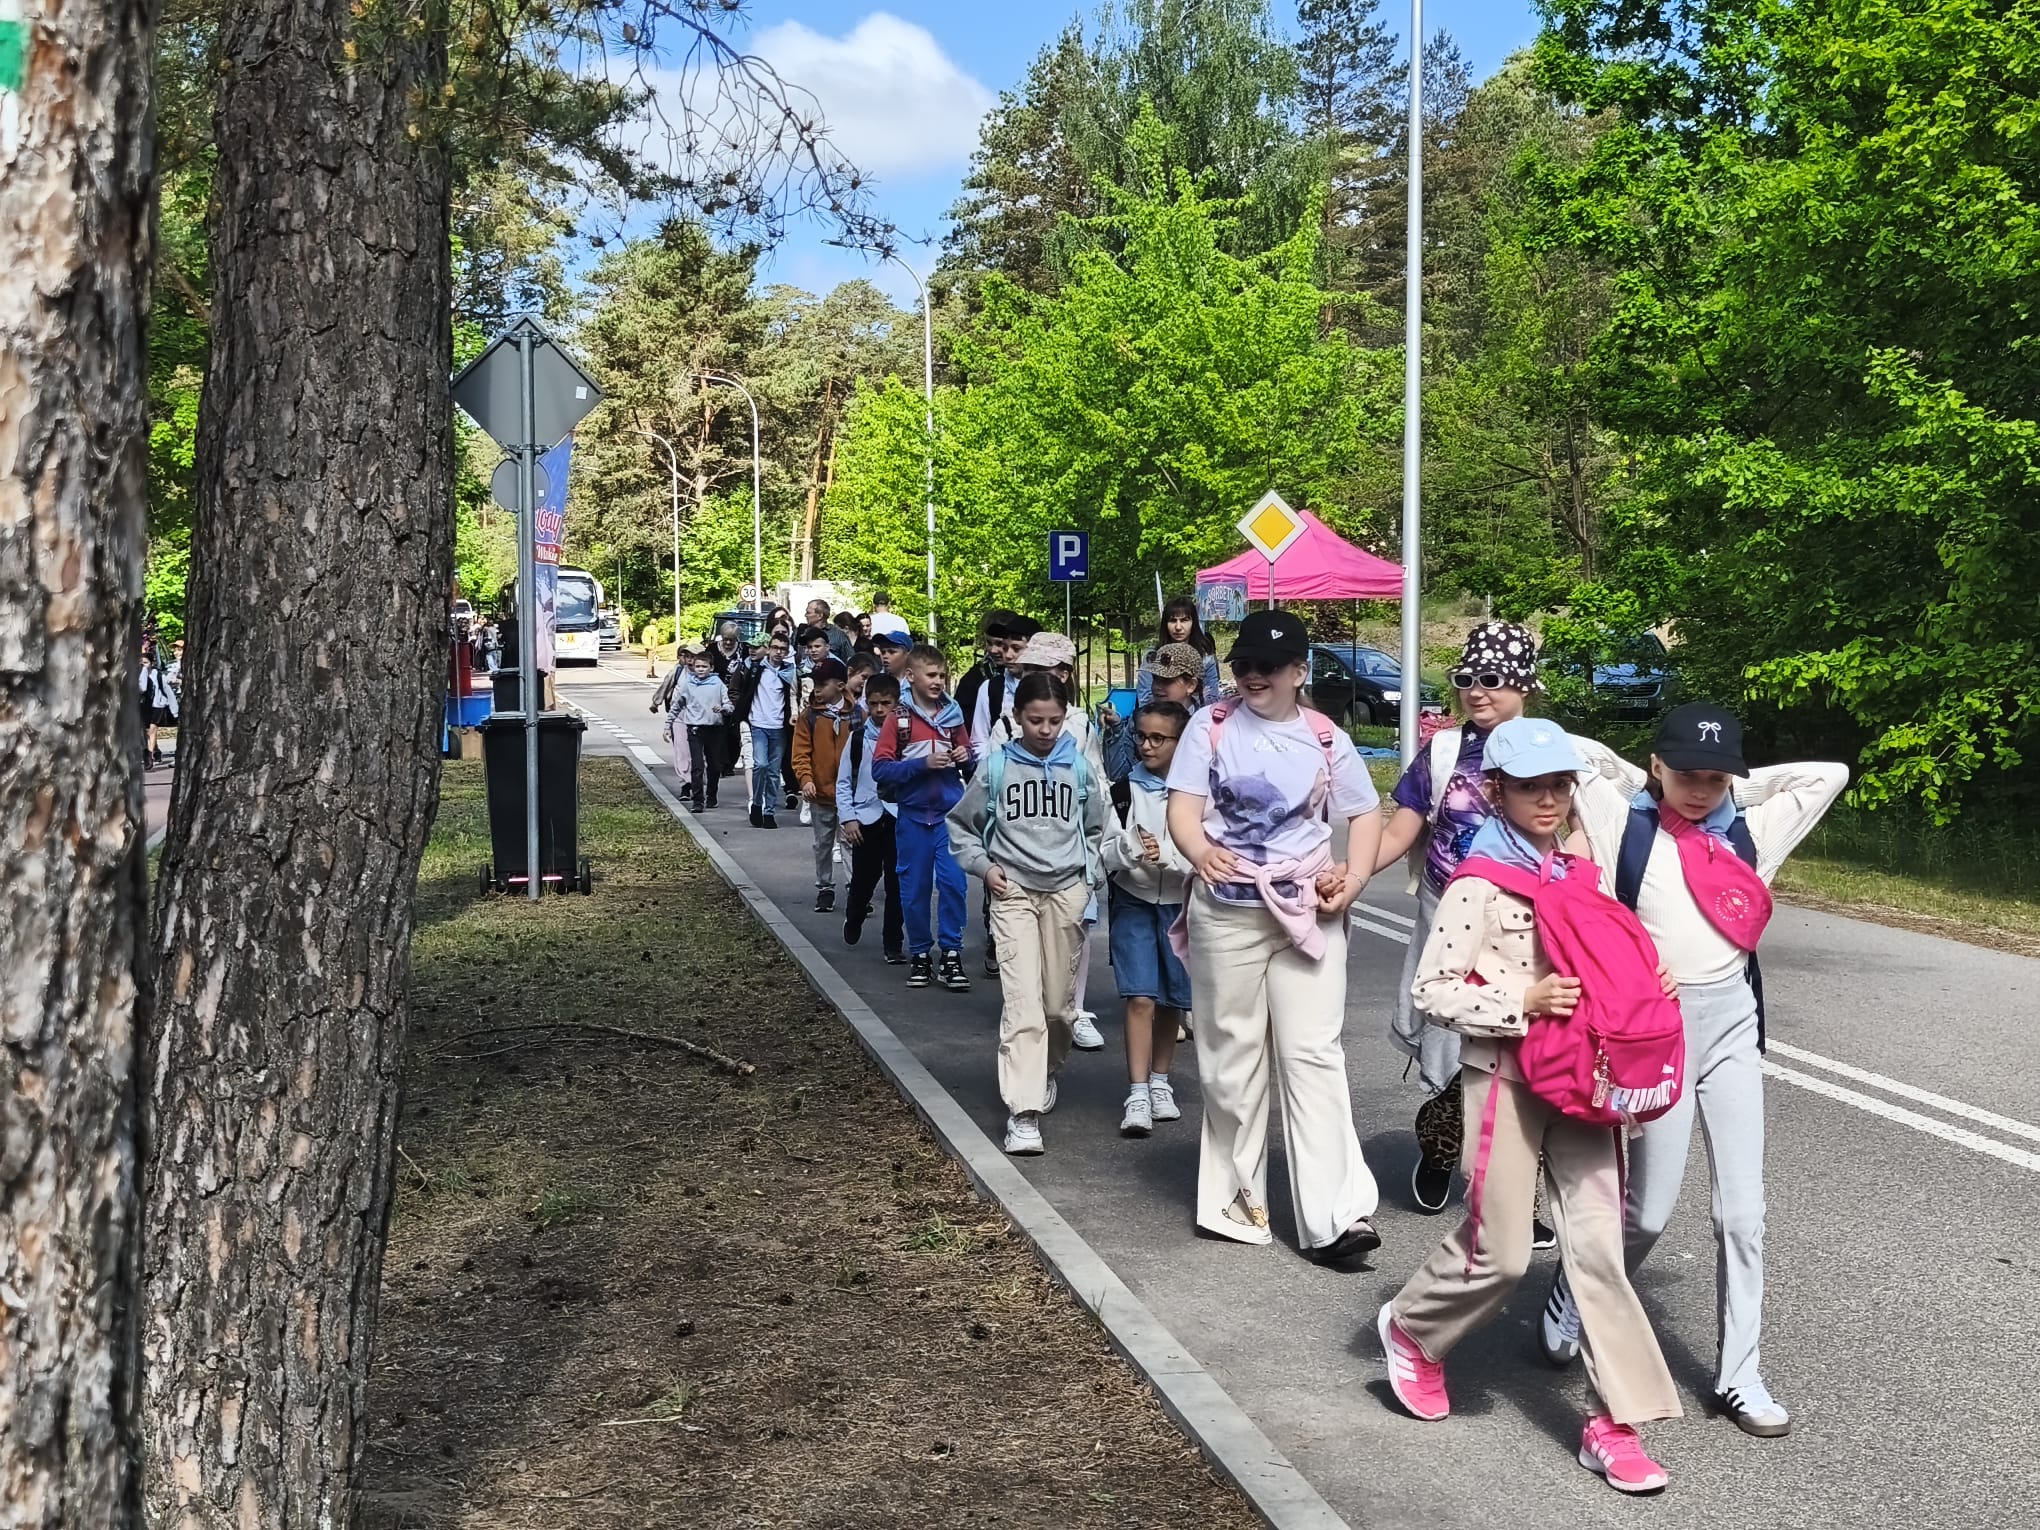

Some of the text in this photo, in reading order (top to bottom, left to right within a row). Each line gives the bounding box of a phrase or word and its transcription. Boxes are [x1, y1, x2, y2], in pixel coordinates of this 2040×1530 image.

[1059, 535, 1080, 566] P
[743, 588, 757, 598] 30
[1207, 585, 1235, 603] SORBETY
[1006, 779, 1073, 823] SOHO
[1611, 1080, 1672, 1113] PUMA
